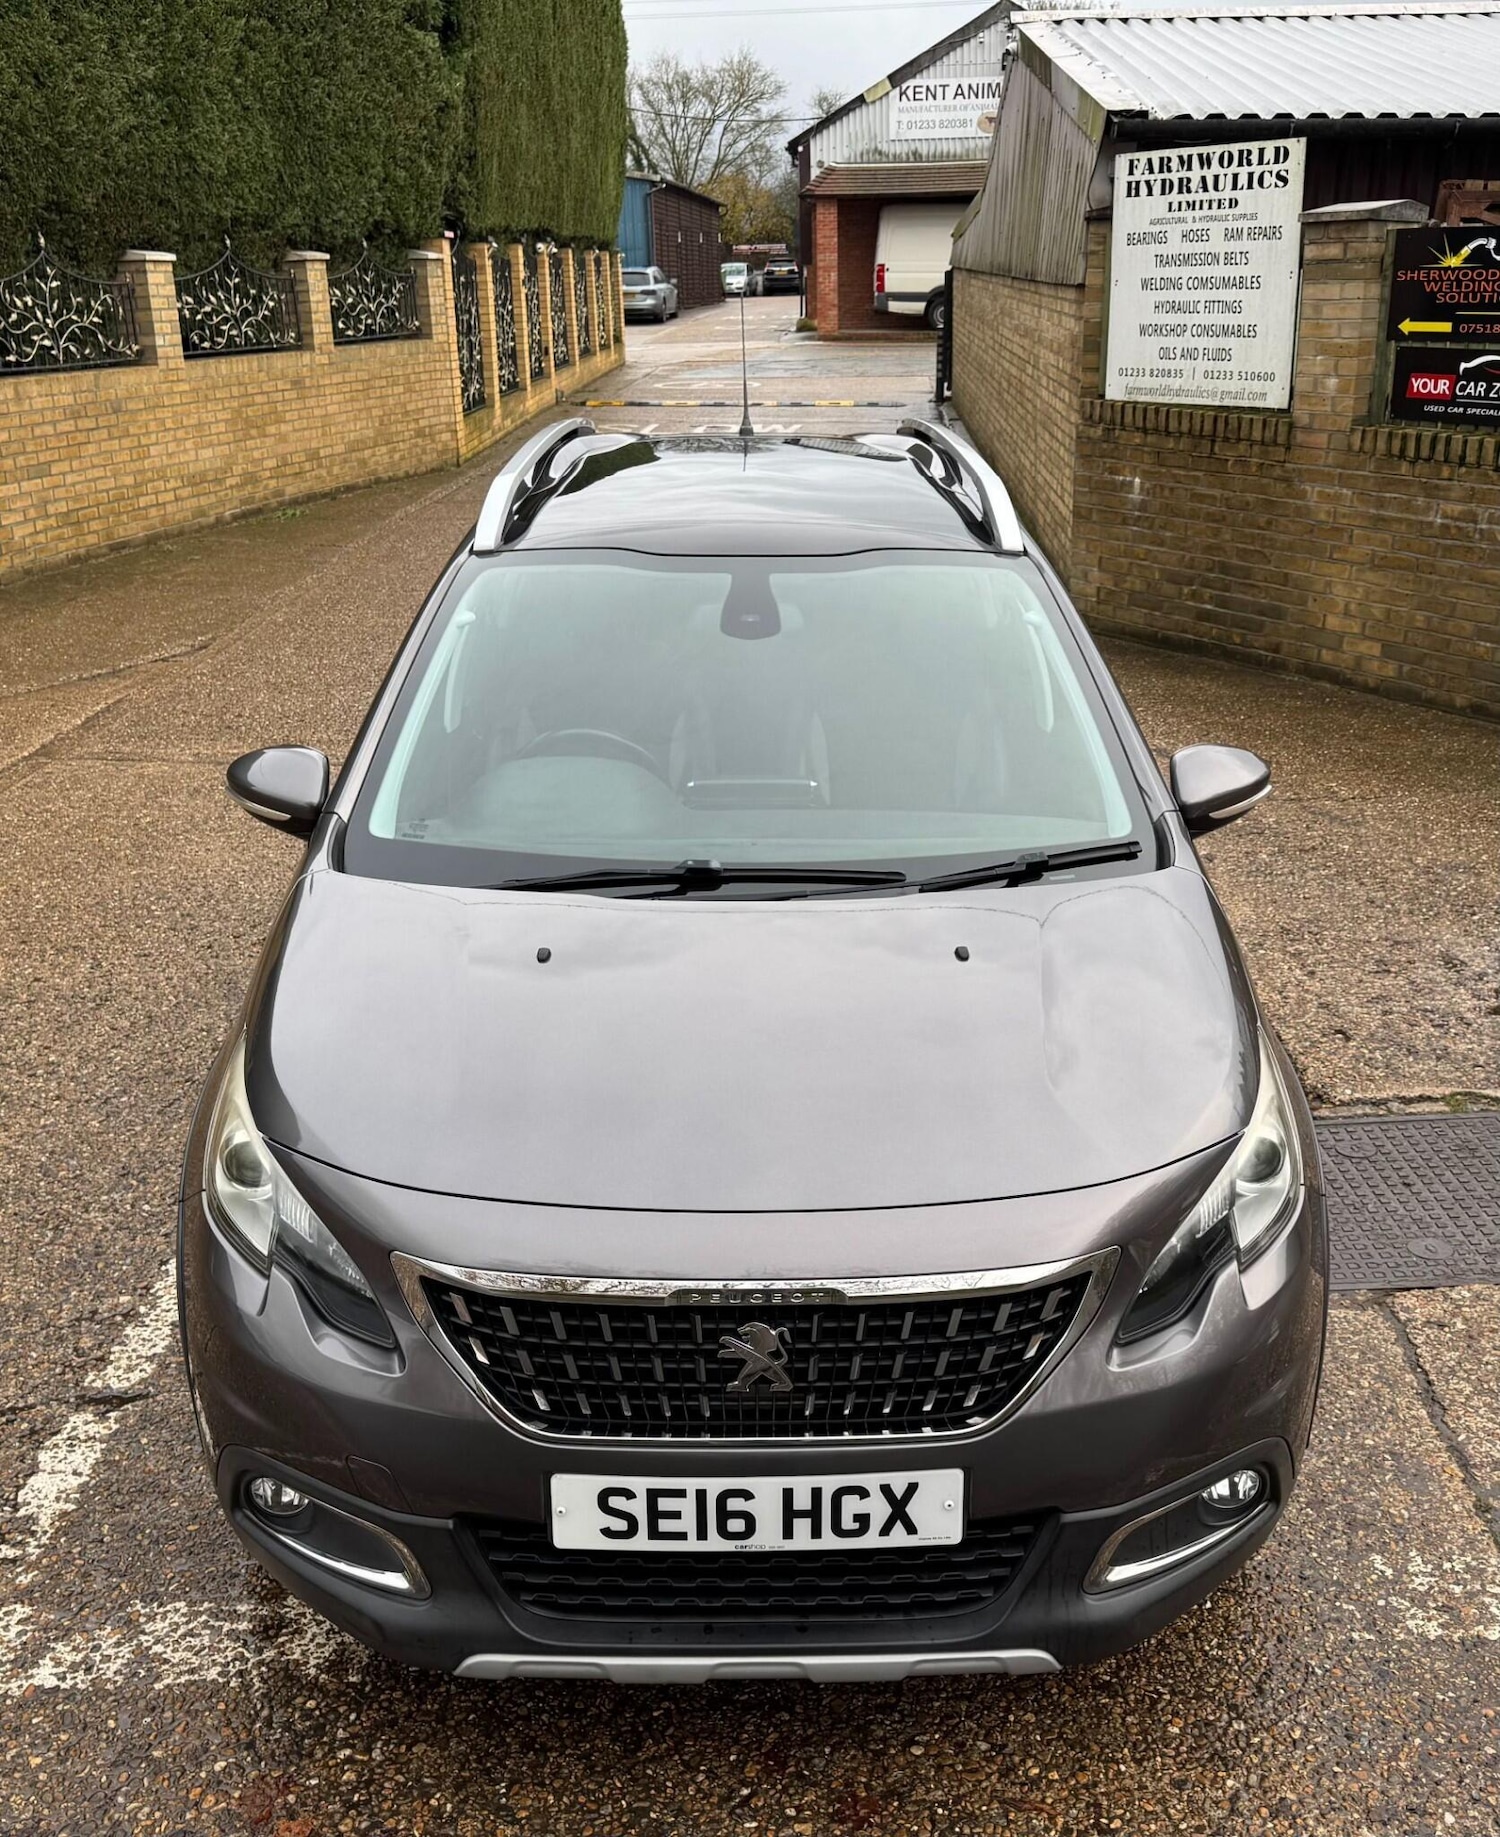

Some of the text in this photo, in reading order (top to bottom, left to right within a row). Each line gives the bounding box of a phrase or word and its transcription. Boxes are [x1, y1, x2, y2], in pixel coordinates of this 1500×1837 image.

[899, 82, 1001, 102] KENT ANIM
[898, 104, 957, 114] MANUFACTURER
[906, 120, 936, 130] 01233
[938, 118, 973, 129] 820381
[1127, 145, 1290, 176] FARMWORLD
[1125, 169, 1289, 198] HYDRAULICS
[1167, 197, 1239, 213] LIMITED
[1149, 212, 1258, 226] AGRICULTURAL & HYDRAULIC SUPPLIES
[1126, 225, 1283, 246] BEARINGS HOSES RAM REPAIRS
[1154, 251, 1249, 268] TRANSMISSION BELTS
[1140, 275, 1261, 291] WELDING COMSUMABLES
[1436, 292, 1500, 304] SOLUTI
[1154, 300, 1243, 315] HYDRAULIC FITTINGS
[1139, 323, 1257, 339] WORKSHOP CONSUMABLES
[1158, 347, 1232, 362] OILS AND FLUIDS
[1118, 367, 1146, 378] 01233
[1149, 368, 1184, 379] 820835
[1203, 369, 1234, 381] 01233
[1237, 371, 1276, 382] 510600
[1411, 377, 1450, 395] YOUR
[1455, 380, 1487, 397] CAR
[1423, 404, 1446, 413] USED
[1447, 406, 1464, 414] CAR
[689, 1292, 824, 1304] PEUGEOT
[596, 1481, 920, 1541] SE16 HGX
